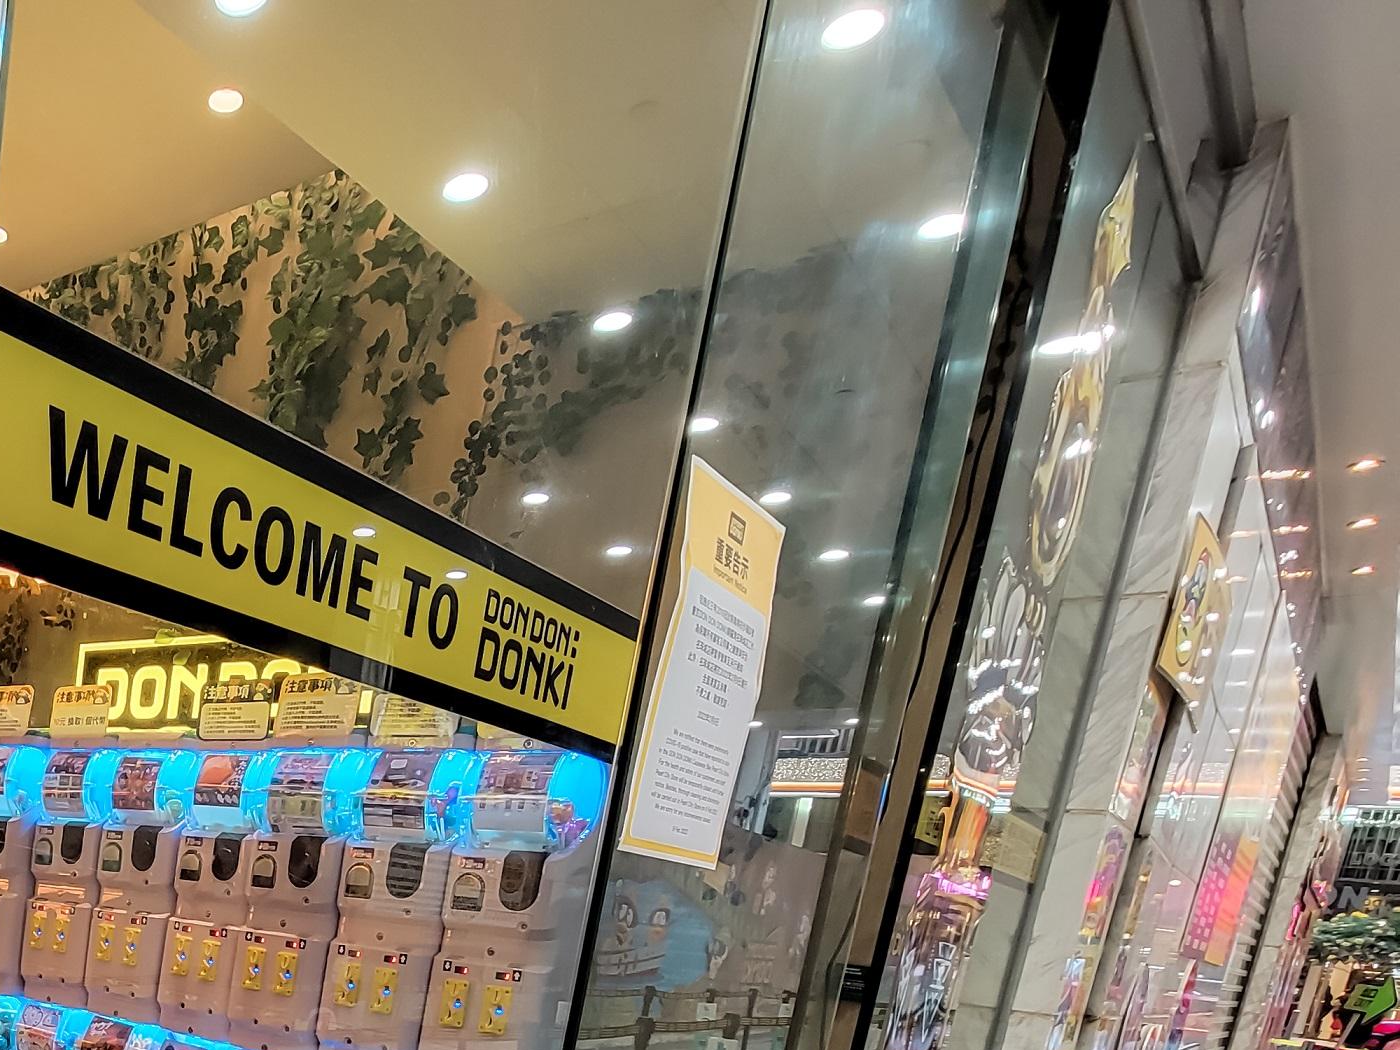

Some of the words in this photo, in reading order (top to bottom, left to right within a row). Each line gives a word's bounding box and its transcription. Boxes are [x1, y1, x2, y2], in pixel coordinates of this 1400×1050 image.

[48, 404, 379, 621] WELCOME
[403, 566, 459, 650] TO
[715, 537, 749, 580] 重要告示
[484, 588, 530, 638] DON
[474, 626, 574, 710] DONKI
